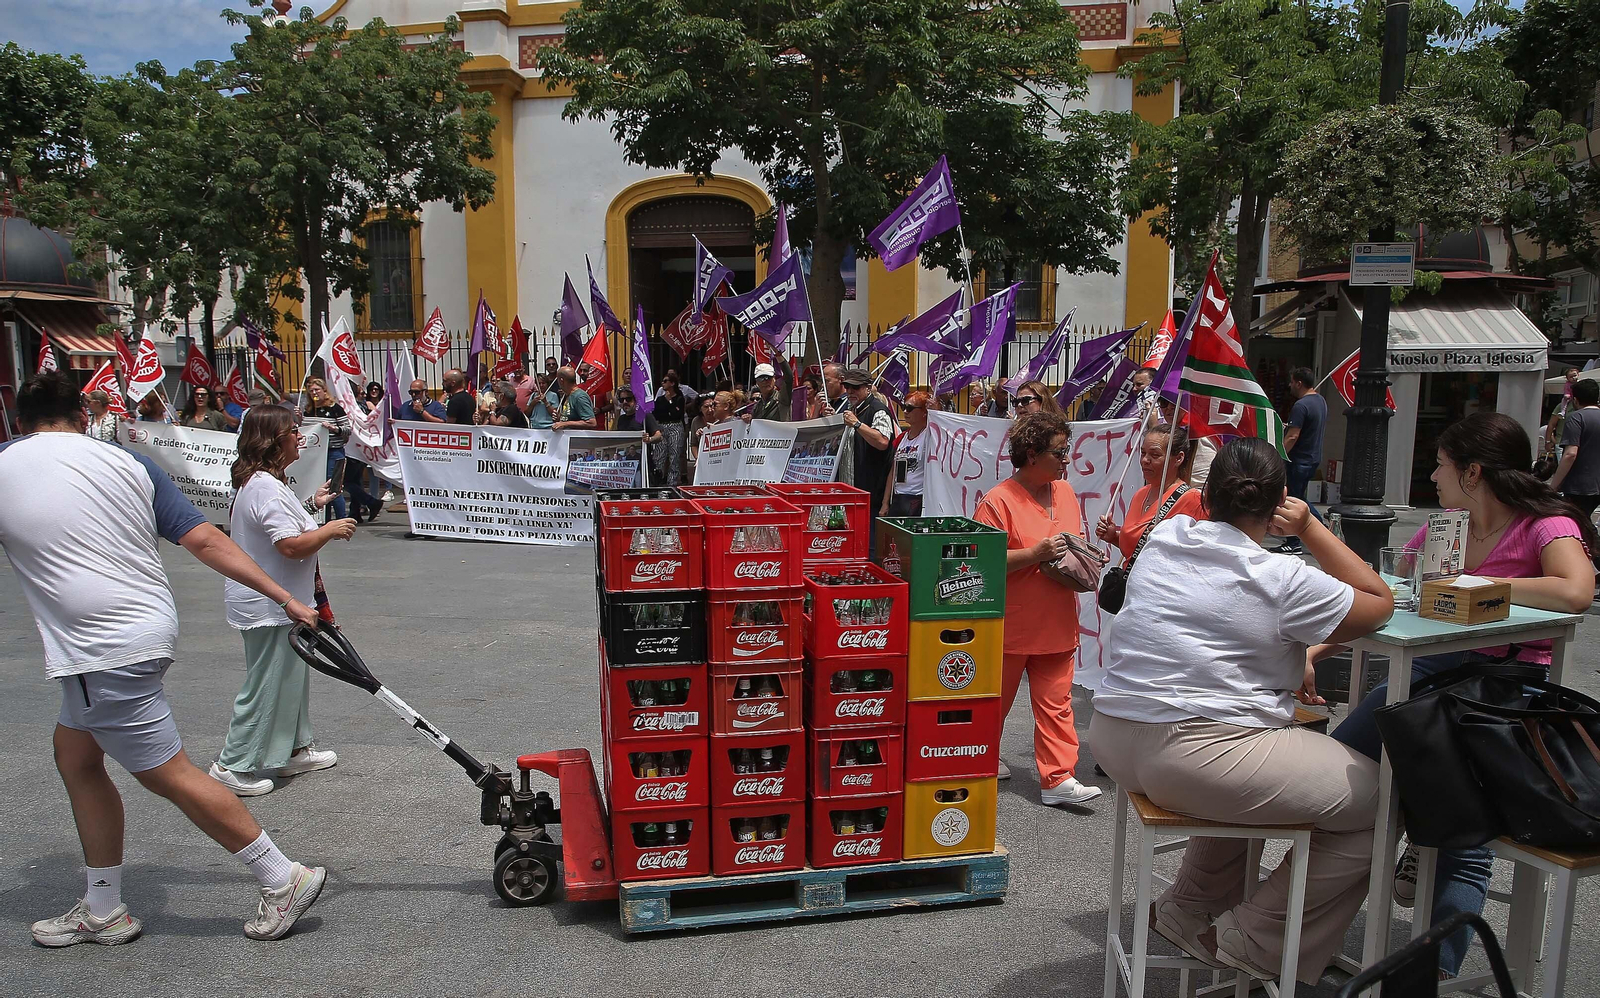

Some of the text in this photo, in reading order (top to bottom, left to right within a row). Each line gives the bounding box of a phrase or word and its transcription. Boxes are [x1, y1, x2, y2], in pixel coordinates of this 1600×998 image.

[1390, 352, 1535, 367] Kiosko Plaza Iglesia
[153, 438, 200, 452] Residencia
[418, 433, 459, 446] CCOO
[478, 436, 548, 454] ¡BASTA YA DE
[477, 460, 561, 479] DISCRIMINACION!
[177, 476, 222, 487] cobertura
[212, 488, 223, 498] de
[420, 488, 449, 498] LINEA
[453, 490, 504, 502] NECESITA
[508, 494, 577, 507] INVERSIONES
[196, 499, 208, 508] de
[210, 500, 230, 510] fijos
[412, 501, 455, 510] REFORMA
[459, 504, 505, 514] INTEGRAL
[537, 510, 593, 519] RESIDENCIA
[466, 515, 495, 524] LIBRE
[527, 520, 553, 528] LINEA
[415, 522, 455, 532] BERTURA
[474, 527, 505, 536] TODAS
[528, 532, 562, 540] PLAZAS
[811, 536, 843, 548] Coca-Cola
[634, 559, 678, 575] Coca-Cola
[734, 561, 782, 579] Coca-Cola
[736, 630, 779, 645] Coca-Cola
[837, 629, 889, 649] Coca-Cola
[737, 702, 779, 717] Coca-Cola
[835, 698, 886, 718] Coca-Cola
[920, 745, 987, 758] Cruzcampo
[733, 777, 785, 796] Coca-Cola
[842, 773, 873, 786] Coca-Cola
[635, 782, 689, 801] Coca-Cola
[735, 844, 786, 864] Coca-Cola
[833, 837, 883, 858] Coca-Cola
[637, 850, 689, 870] Coca-Cola
